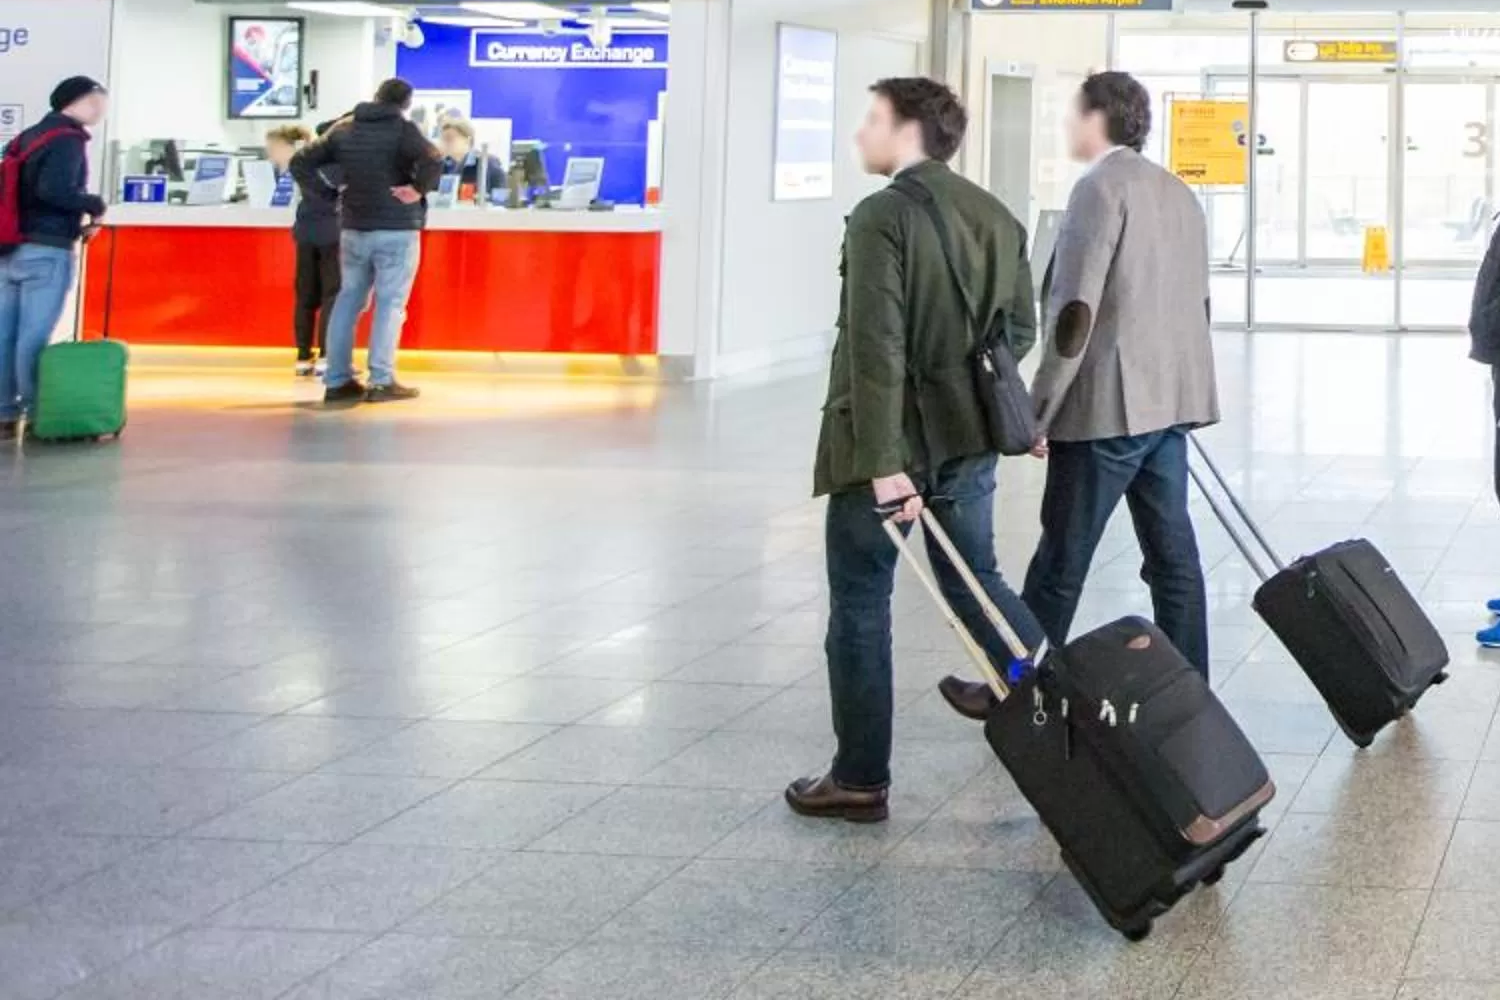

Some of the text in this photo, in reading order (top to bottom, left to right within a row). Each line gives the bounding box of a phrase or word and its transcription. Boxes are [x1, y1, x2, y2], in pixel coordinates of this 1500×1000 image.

[487, 41, 655, 64] Currency Exchange
[1463, 120, 1488, 158] 3
